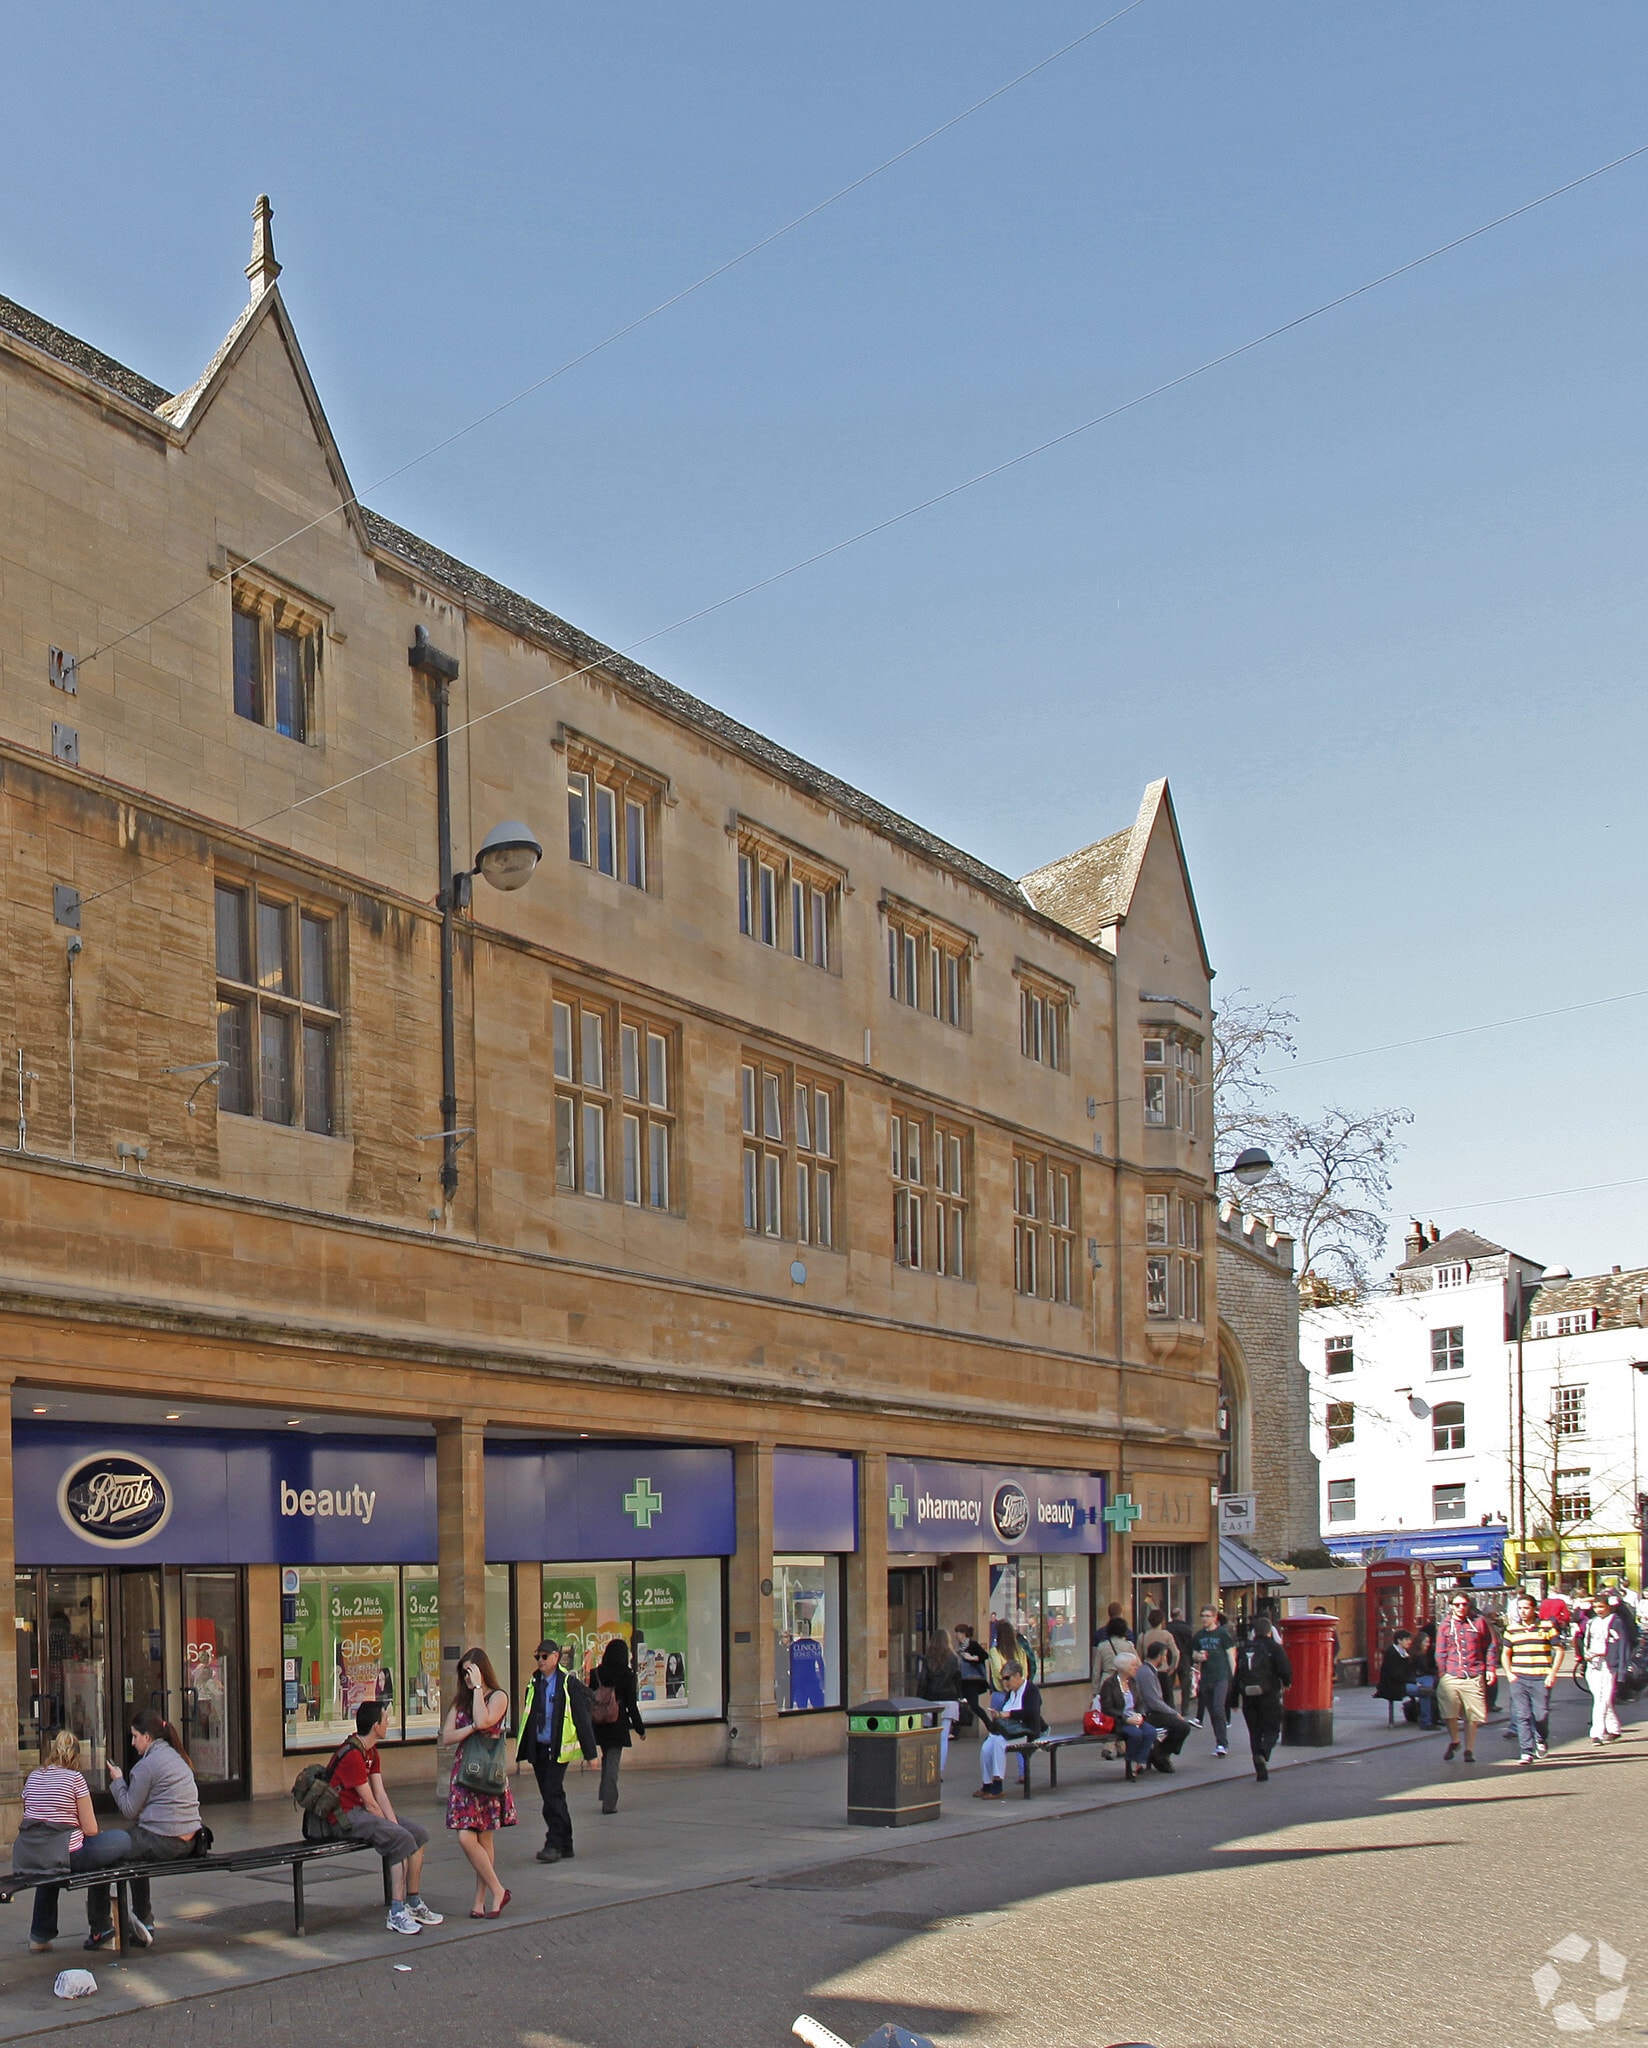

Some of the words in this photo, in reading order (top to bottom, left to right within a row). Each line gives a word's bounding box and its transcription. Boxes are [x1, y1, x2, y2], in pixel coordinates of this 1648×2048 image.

[80, 1473, 153, 1523] Boots
[280, 1479, 376, 1524] beauty
[1147, 1489, 1194, 1524] EAST
[917, 1491, 982, 1526] pharmacy
[1000, 1494, 1029, 1528] Boots
[1037, 1498, 1075, 1529] beauty
[1221, 1520, 1252, 1531] EAST
[363, 1597, 374, 1606] Mix
[553, 1591, 562, 1609] 2
[563, 1591, 574, 1600] Mix
[623, 1589, 632, 1607] 3
[644, 1588, 653, 1606] 2
[654, 1588, 665, 1596] Mix
[654, 1596, 674, 1605] Match
[332, 1598, 341, 1617] 3
[342, 1606, 353, 1616] for
[354, 1597, 363, 1616] 2
[363, 1606, 383, 1616] Match
[410, 1595, 418, 1614] 3
[419, 1604, 429, 1614] for
[430, 1595, 438, 1614] 2
[563, 1600, 584, 1609] Match
